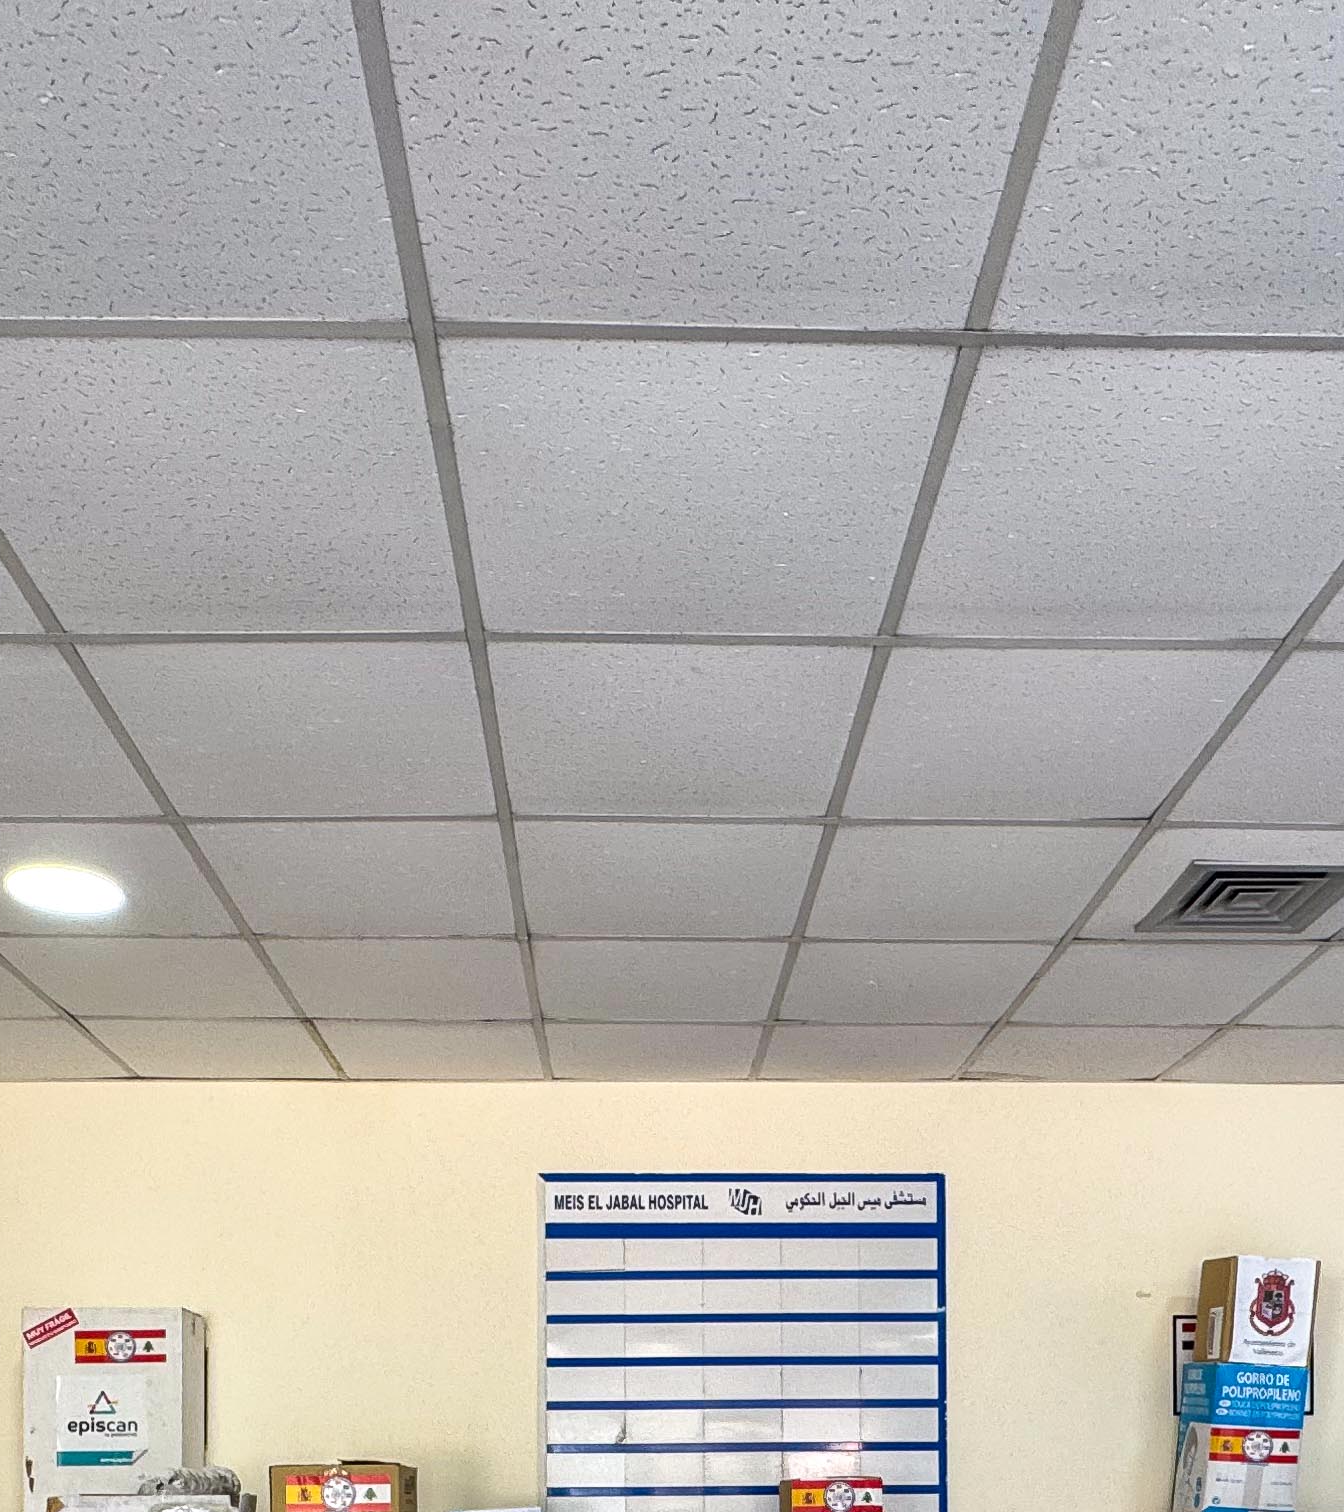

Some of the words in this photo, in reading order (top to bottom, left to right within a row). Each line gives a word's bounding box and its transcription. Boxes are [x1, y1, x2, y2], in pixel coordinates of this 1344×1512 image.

[554, 1194, 584, 1210] MEIS
[588, 1194, 604, 1210] EL
[606, 1194, 645, 1210] JABAL
[648, 1194, 708, 1210] HOSPITAL
[884, 1190, 927, 1209] مستشفى
[1236, 1371, 1274, 1386] GORRO
[1275, 1374, 1290, 1386] DE
[1222, 1386, 1301, 1401] POLIPROPILENO
[67, 1416, 138, 1436] episcan
